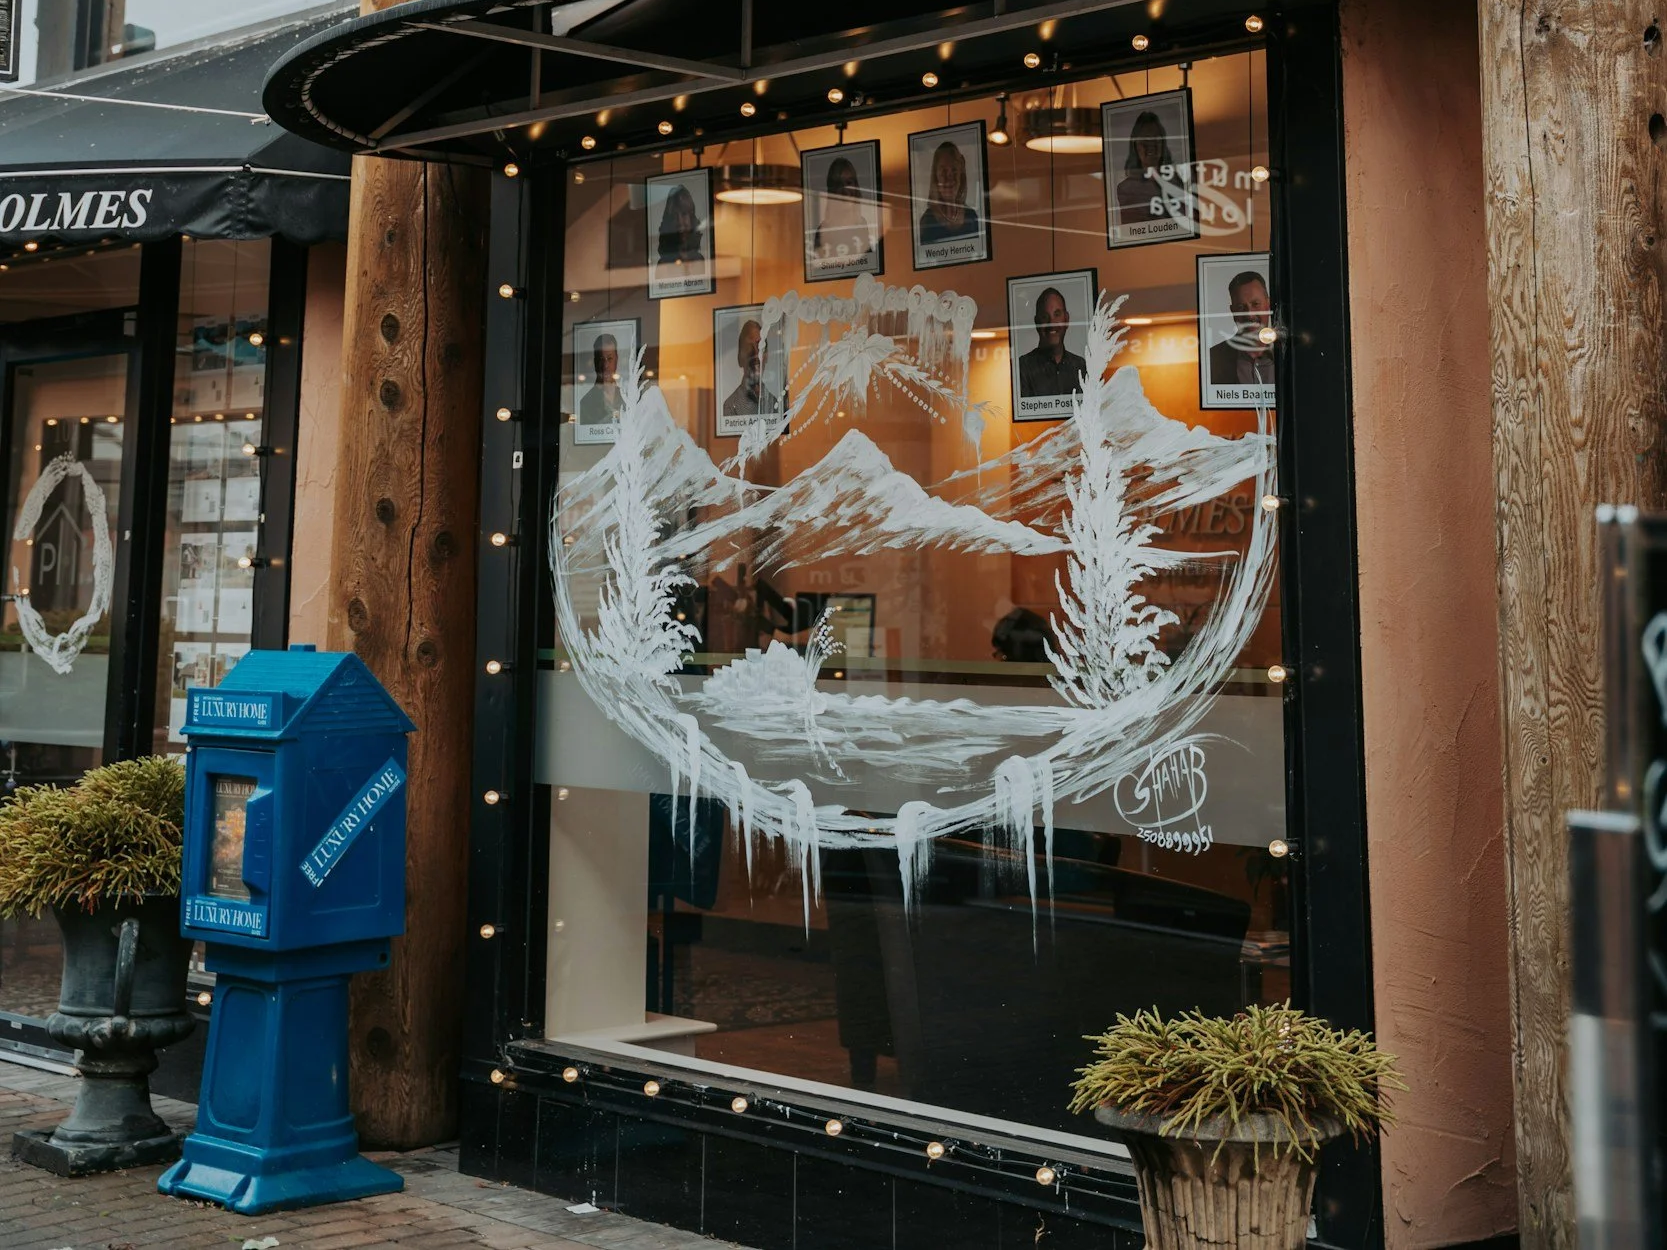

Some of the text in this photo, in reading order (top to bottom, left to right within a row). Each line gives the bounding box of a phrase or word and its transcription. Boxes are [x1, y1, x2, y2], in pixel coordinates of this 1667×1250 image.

[0, 189, 153, 233] OLMES
[1129, 222, 1179, 236] Inez Louden
[925, 243, 975, 258] Wendy Herrick
[846, 258, 868, 267] Jones
[1216, 389, 1240, 399] Niels
[1020, 400, 1052, 411] Stephen
[725, 417, 746, 427] Patrick
[589, 427, 604, 436] Ross
[202, 700, 268, 719] LUXURY HOME
[313, 807, 360, 869] LUXURY
[357, 767, 398, 815] HOME
[301, 860, 320, 885] FREE
[184, 899, 192, 926] FREE
[194, 904, 263, 929] LUXURY HOME
